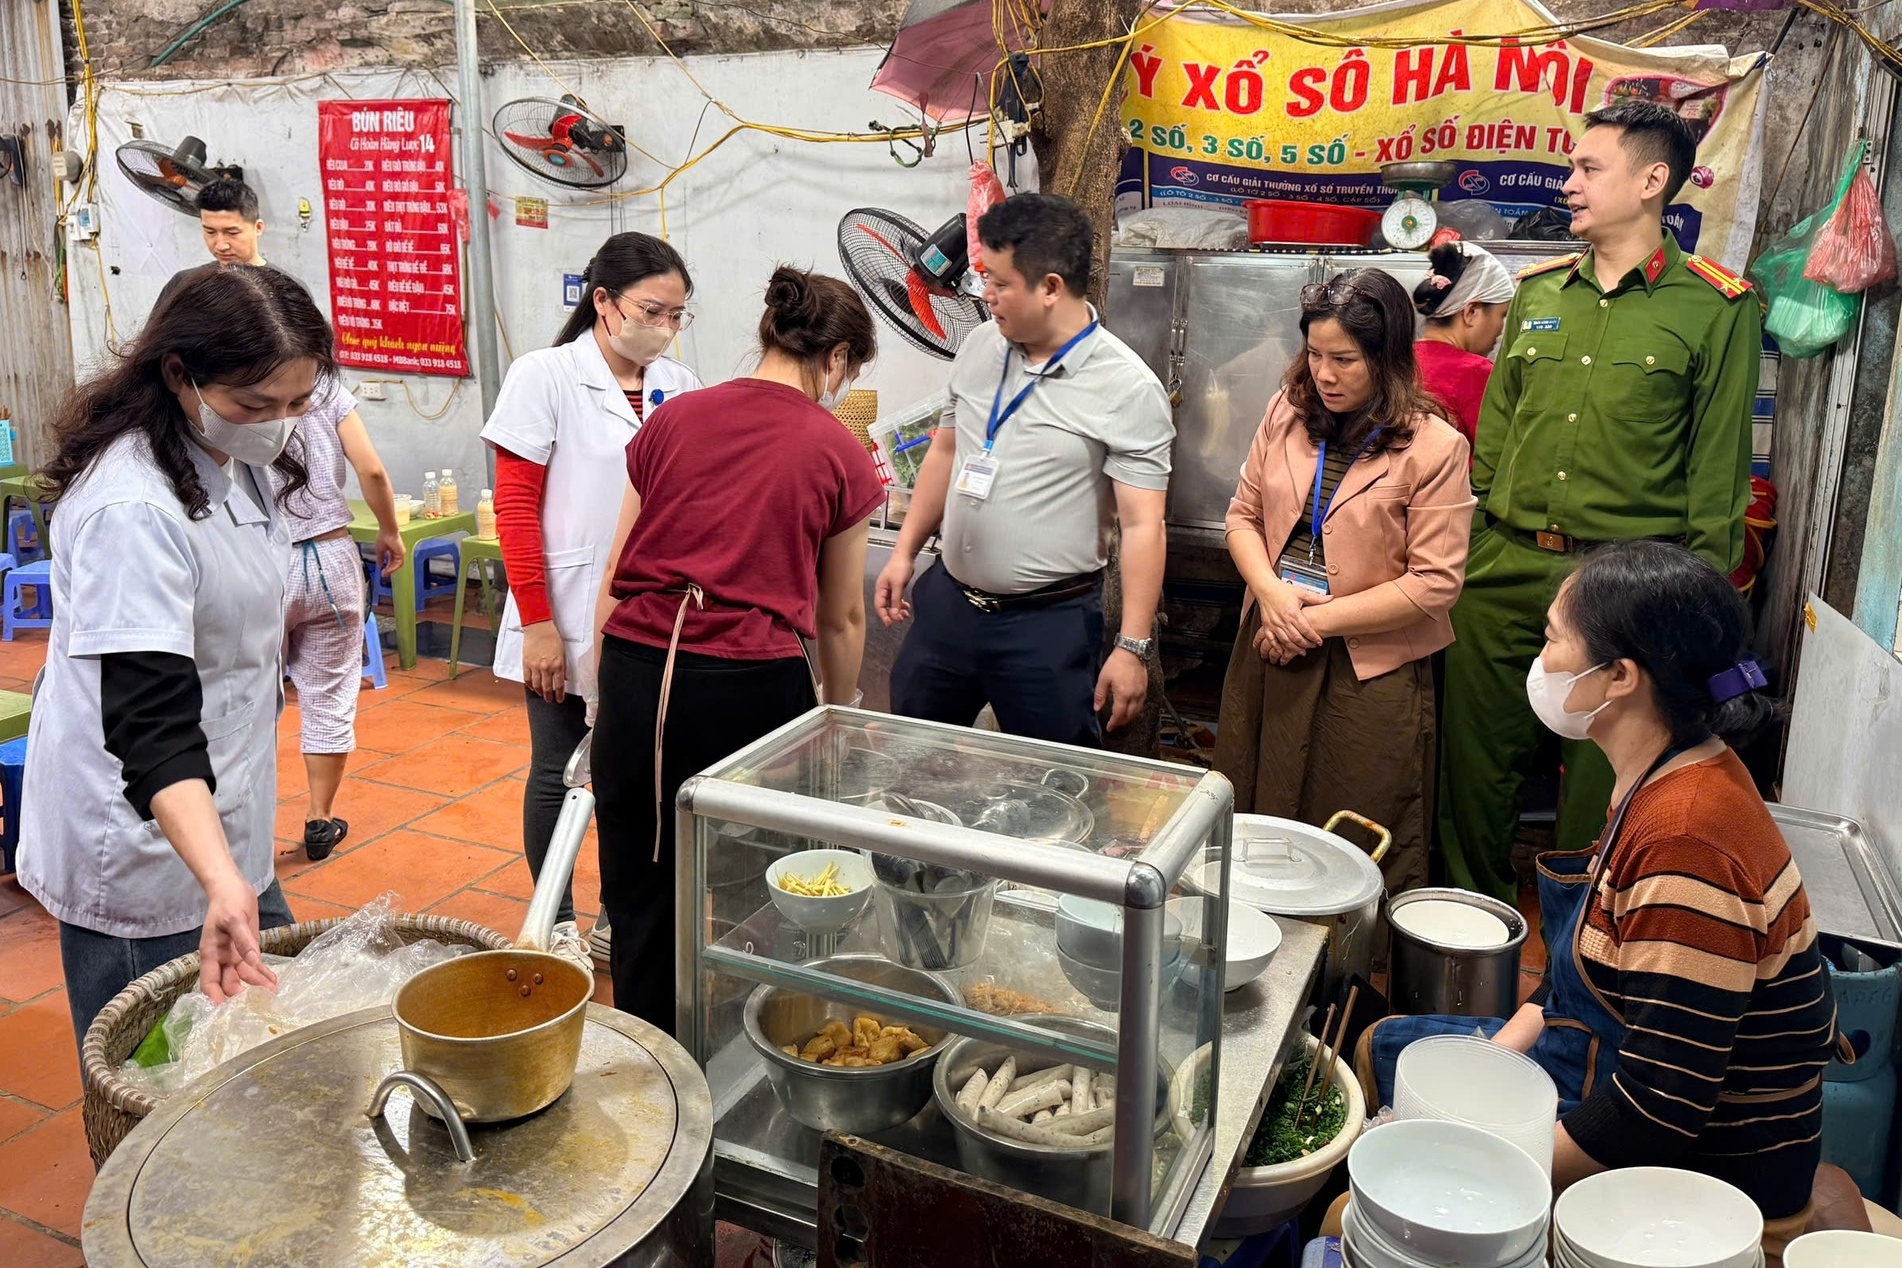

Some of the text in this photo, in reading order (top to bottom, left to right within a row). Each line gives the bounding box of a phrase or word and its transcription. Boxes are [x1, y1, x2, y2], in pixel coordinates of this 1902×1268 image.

[1129, 44, 1163, 99] Ý
[1181, 50, 1270, 115] XỔ
[352, 107, 414, 132] BÚN RIÊU
[419, 134, 435, 153] 14
[1129, 119, 1144, 139] 2
[1151, 124, 1193, 153] SỐ,
[1202, 135, 1218, 154] 3
[1227, 135, 1271, 163] SỐ,
[1281, 145, 1297, 164] 5
[1306, 133, 1348, 165] SỐ
[1375, 124, 1416, 162] XỔ
[1420, 115, 1460, 153] SỐ
[1465, 119, 1537, 154] ĐIỆN
[1546, 128, 1575, 154] TO
[1221, 173, 1240, 185] CẤU
[1499, 171, 1567, 191] CƠ CẤU GIẢ
